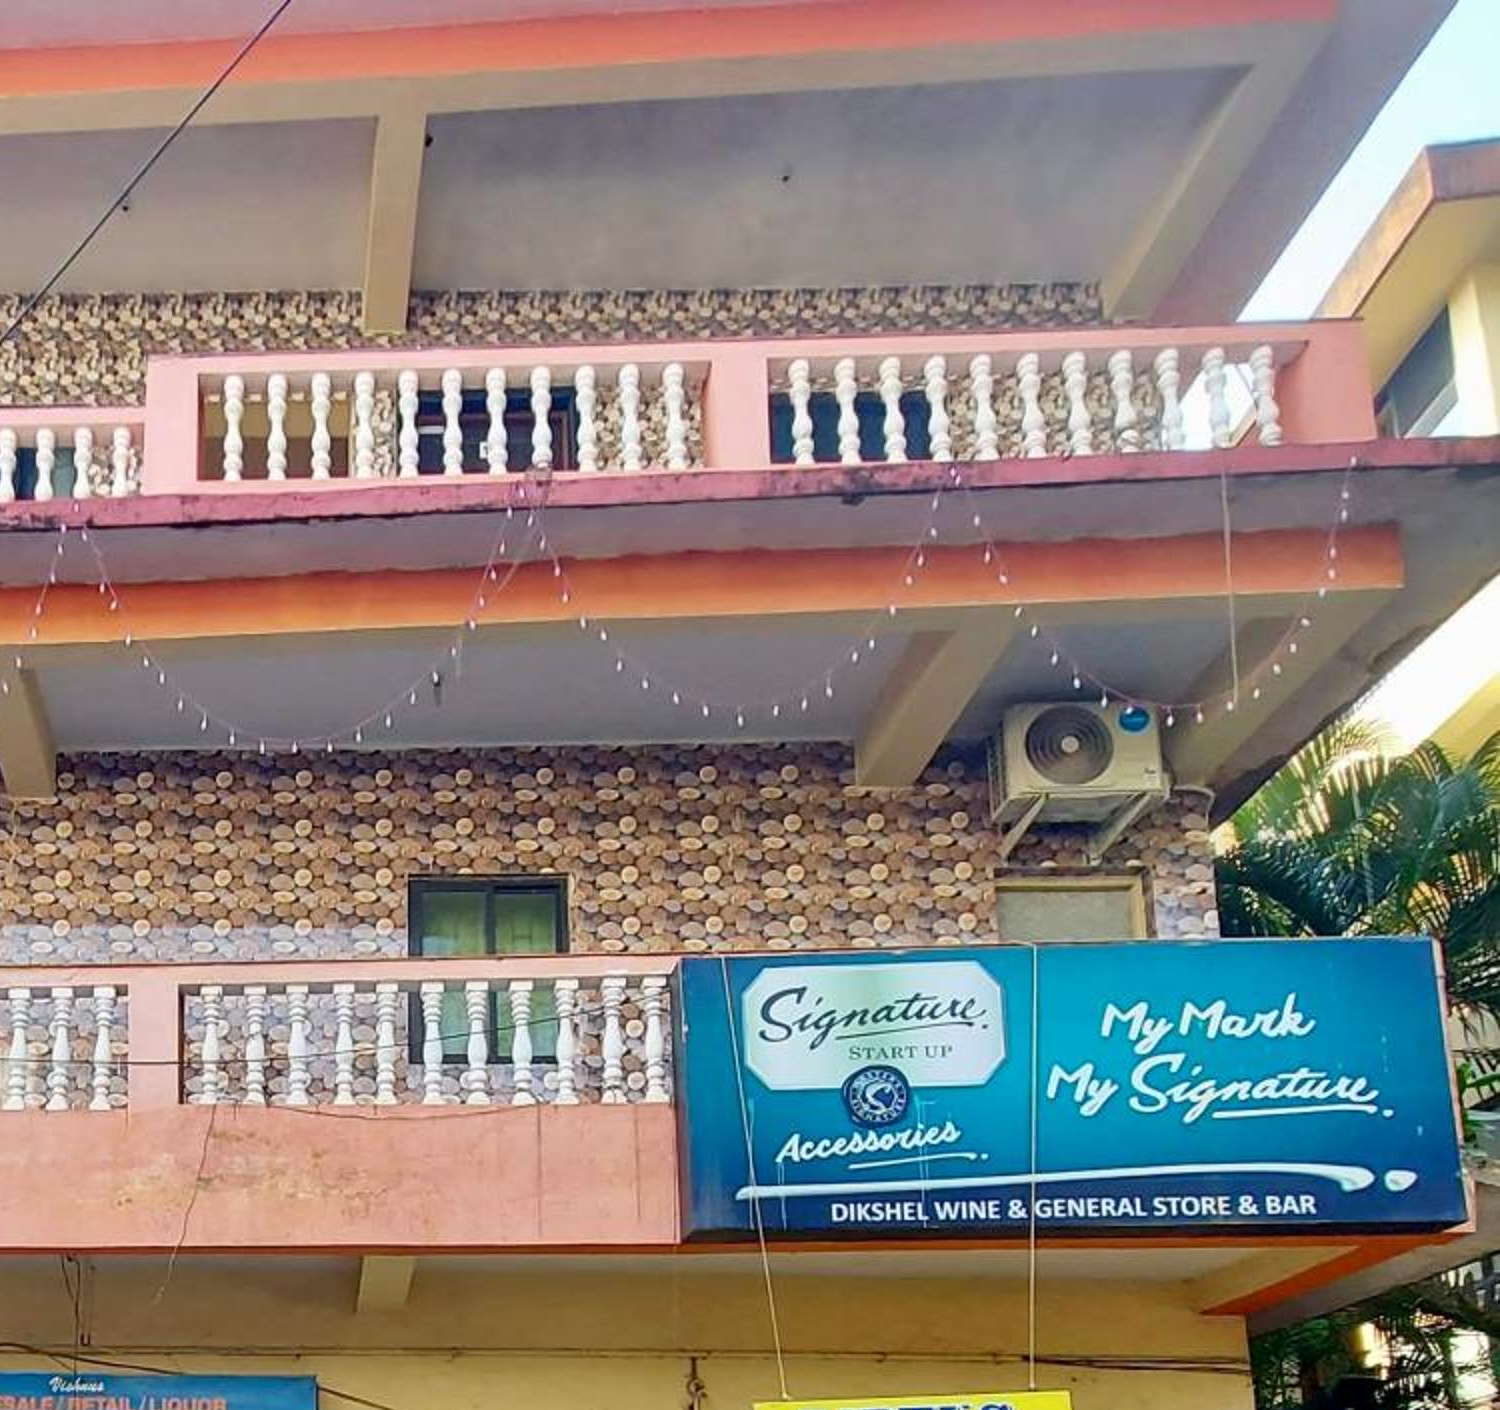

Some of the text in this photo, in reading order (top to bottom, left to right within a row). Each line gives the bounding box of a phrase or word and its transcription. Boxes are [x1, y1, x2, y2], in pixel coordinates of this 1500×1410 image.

[1101, 992, 1316, 1055] My Mark
[849, 1045, 953, 1060] START UP
[1047, 1063, 1118, 1116] My
[776, 1121, 961, 1163] Accessories
[831, 1195, 1317, 1222] DIKSHEL WINE & GENERAL STORE & BAR
